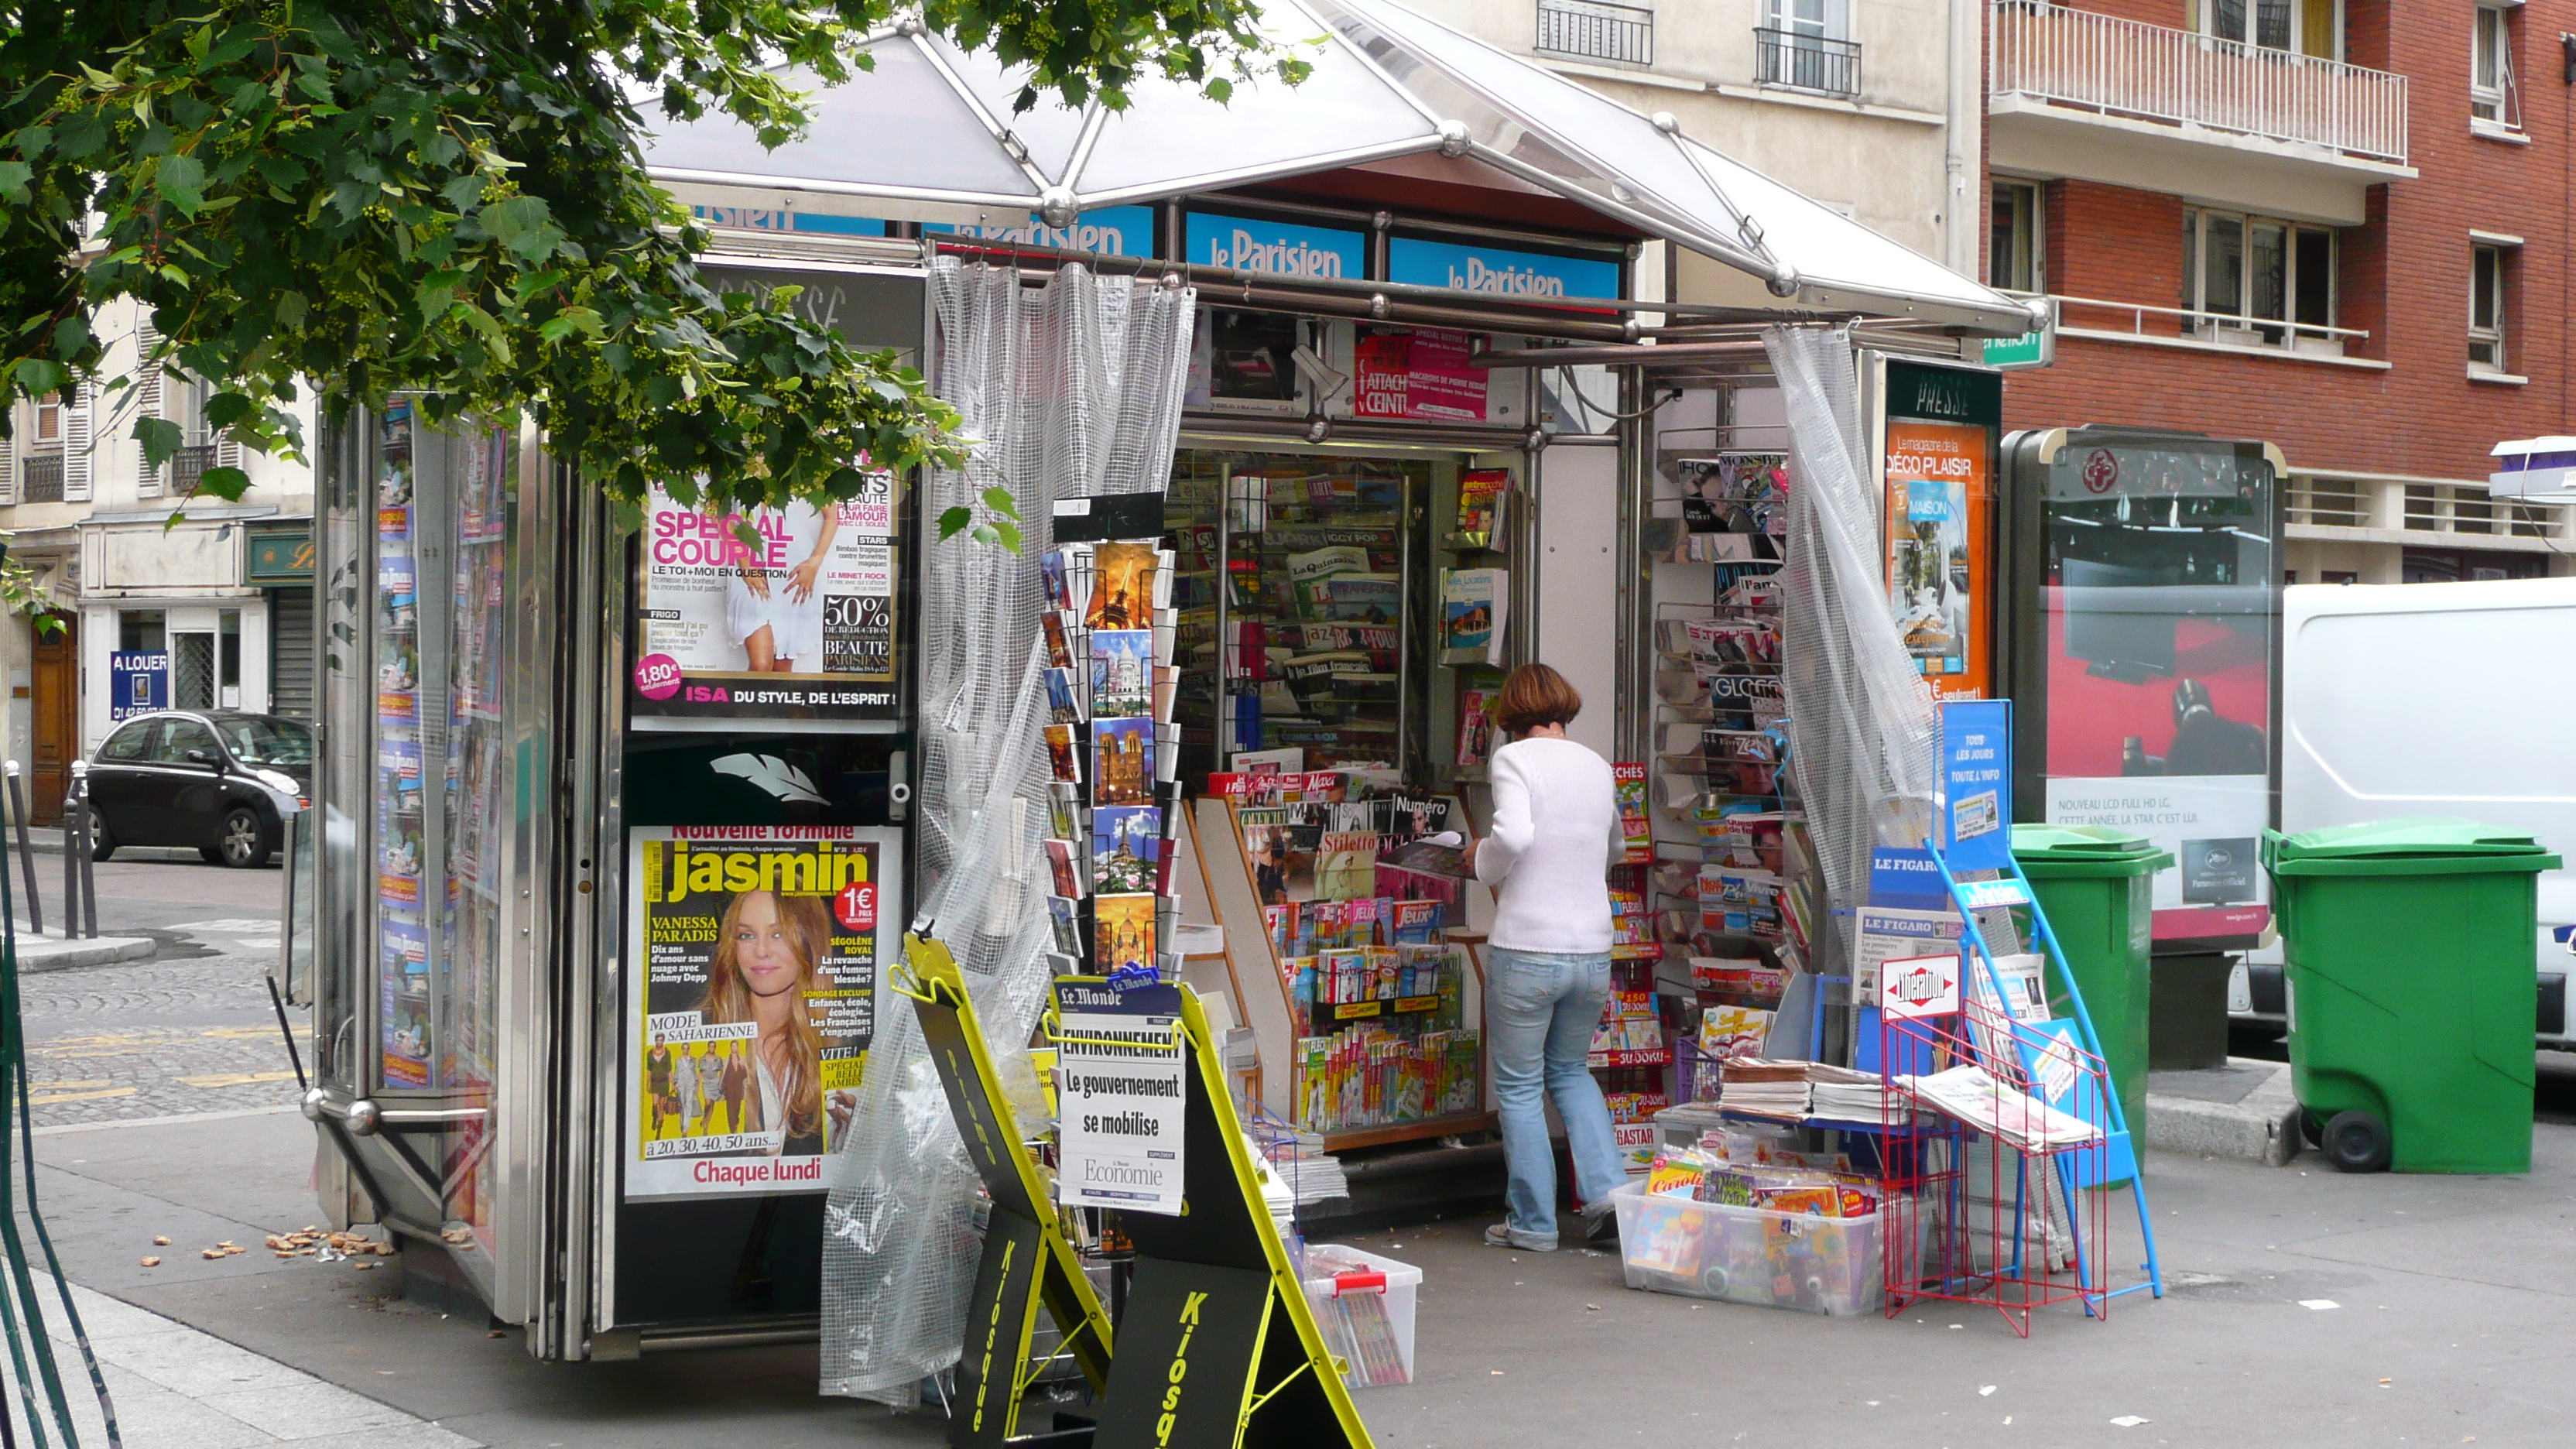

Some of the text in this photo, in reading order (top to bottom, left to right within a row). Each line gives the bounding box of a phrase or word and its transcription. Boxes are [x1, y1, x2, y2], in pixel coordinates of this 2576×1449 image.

[1212, 229, 1341, 278] le Parisien
[1367, 373, 1408, 392] ATTACH
[1907, 437, 1941, 454] magazine
[1886, 451, 1972, 477] DÉCO PLAISIR
[654, 511, 794, 542] SPECAL
[858, 536, 888, 545] STARS
[653, 538, 787, 568] COUPLE
[859, 546, 887, 557] tragiques
[858, 560, 887, 568] magiques
[653, 565, 787, 579] LE TOI+MOI EN QUESTION
[650, 610, 678, 619] FRIGO
[824, 596, 889, 627] 50%
[651, 621, 684, 629] Comment
[699, 622, 708, 631] pu
[824, 640, 889, 656] BEAUTE
[113, 655, 167, 671] A LOUER
[824, 655, 889, 666] PARISIENS
[639, 676, 680, 692] seulement
[685, 687, 889, 707] ISA DU STYLE, DE L'ESPRIT
[114, 707, 124, 719] 01
[1965, 735, 1985, 746] TOUS
[1956, 748, 1994, 761] LES JOURS
[1307, 773, 1336, 790] Maxi
[1951, 769, 1999, 783] TOUTE L'INFO
[1396, 796, 1447, 815] Numéro
[2058, 798, 2156, 810] NOUVEAU LCD FULL HD
[2121, 814, 2130, 824] LA
[2134, 814, 2154, 824] STAR
[2156, 814, 2180, 824] C'EST
[1324, 832, 1375, 852] Stiletto
[1874, 858, 1892, 870] LE
[668, 841, 868, 903] jasmin
[844, 888, 872, 917] 1€
[1355, 906, 1376, 920] JEUX
[652, 916, 718, 930] VANESSA
[1865, 918, 1932, 932] LE FIGARO
[652, 930, 718, 943] PARADIS
[830, 937, 872, 947] SÉGOLÈNE
[651, 944, 666, 954] Dix
[844, 946, 872, 954] ROYAL
[1871, 942, 1897, 951] premiers
[651, 954, 686, 964] d'amour
[822, 956, 872, 964] La revanche
[651, 965, 678, 975] nuage
[817, 965, 872, 975] d'une femme
[650, 973, 707, 984] Johnny Depp
[834, 974, 872, 984] blessée?
[1124, 975, 1155, 989] Monde
[802, 988, 872, 998] SONDAGE EXCLUSIF
[1061, 987, 1122, 1006] Le Monde
[1626, 993, 1646, 1002] 150
[808, 998, 872, 1009] Enfance, école,
[649, 1014, 697, 1031] MODE
[810, 1017, 871, 1028] Les Françaises
[667, 1024, 755, 1043] SAHARIENNE
[820, 1027, 866, 1037] s'engagent
[1063, 1029, 1181, 1059] ENVIRONNEMENT
[820, 1048, 851, 1060] VITE
[1066, 1068, 1180, 1099] Le gouvernement
[1083, 1110, 1160, 1137] se mobilise
[1616, 1128, 1654, 1146] GASTAR
[646, 1143, 654, 1156] à
[657, 1140, 676, 1156] 20,
[678, 1138, 699, 1154] 30,
[702, 1136, 721, 1152] 40,
[725, 1135, 742, 1148] 50
[693, 1160, 821, 1187] Chaque lundi
[1084, 1158, 1163, 1186] Economie
[1156, 1291, 1209, 1449] Kiosq
